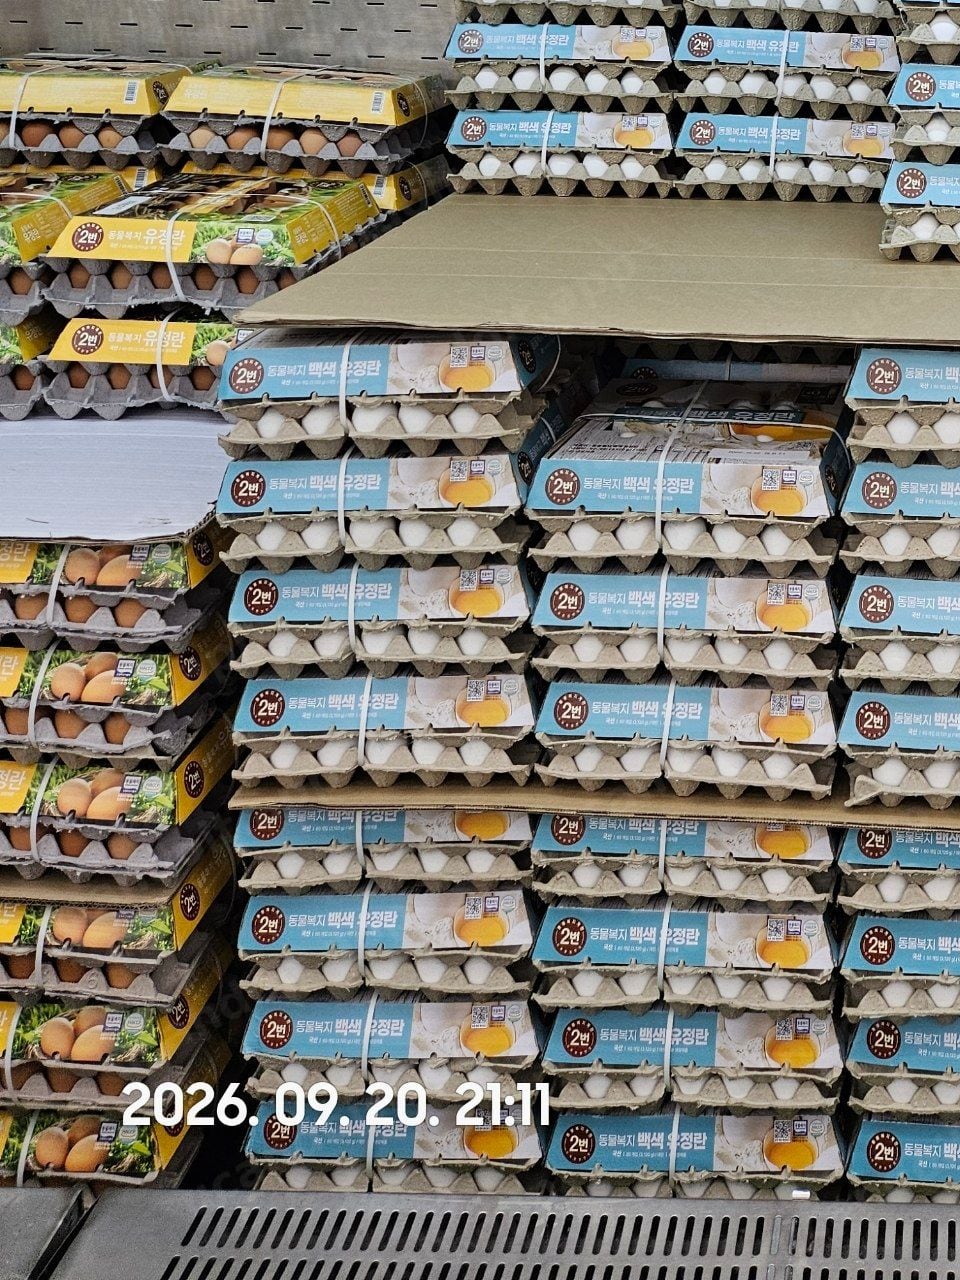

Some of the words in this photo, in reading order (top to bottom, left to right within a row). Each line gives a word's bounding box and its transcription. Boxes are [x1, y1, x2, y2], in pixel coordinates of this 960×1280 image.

[913, 79, 929, 93] 2번
[466, 123, 482, 135] 2번
[695, 127, 711, 138] 2번
[78, 230, 98, 244] 2번
[78, 332, 98, 346] 2번
[236, 368, 257, 383] 2번
[308, 361, 337, 377] 백색
[874, 368, 894, 384] 2번
[553, 478, 573, 495] 2번
[623, 476, 651, 492] 백색
[251, 588, 272, 605] 2번
[321, 583, 350, 599] 백색
[561, 702, 582, 719] 2번
[631, 701, 659, 718] 백색
[258, 916, 278, 933] 2번
[328, 912, 355, 928] 백색
[569, 1135, 589, 1152] 2번
[637, 1131, 664, 1149] 백색
[874, 1142, 894, 1161] 2번
